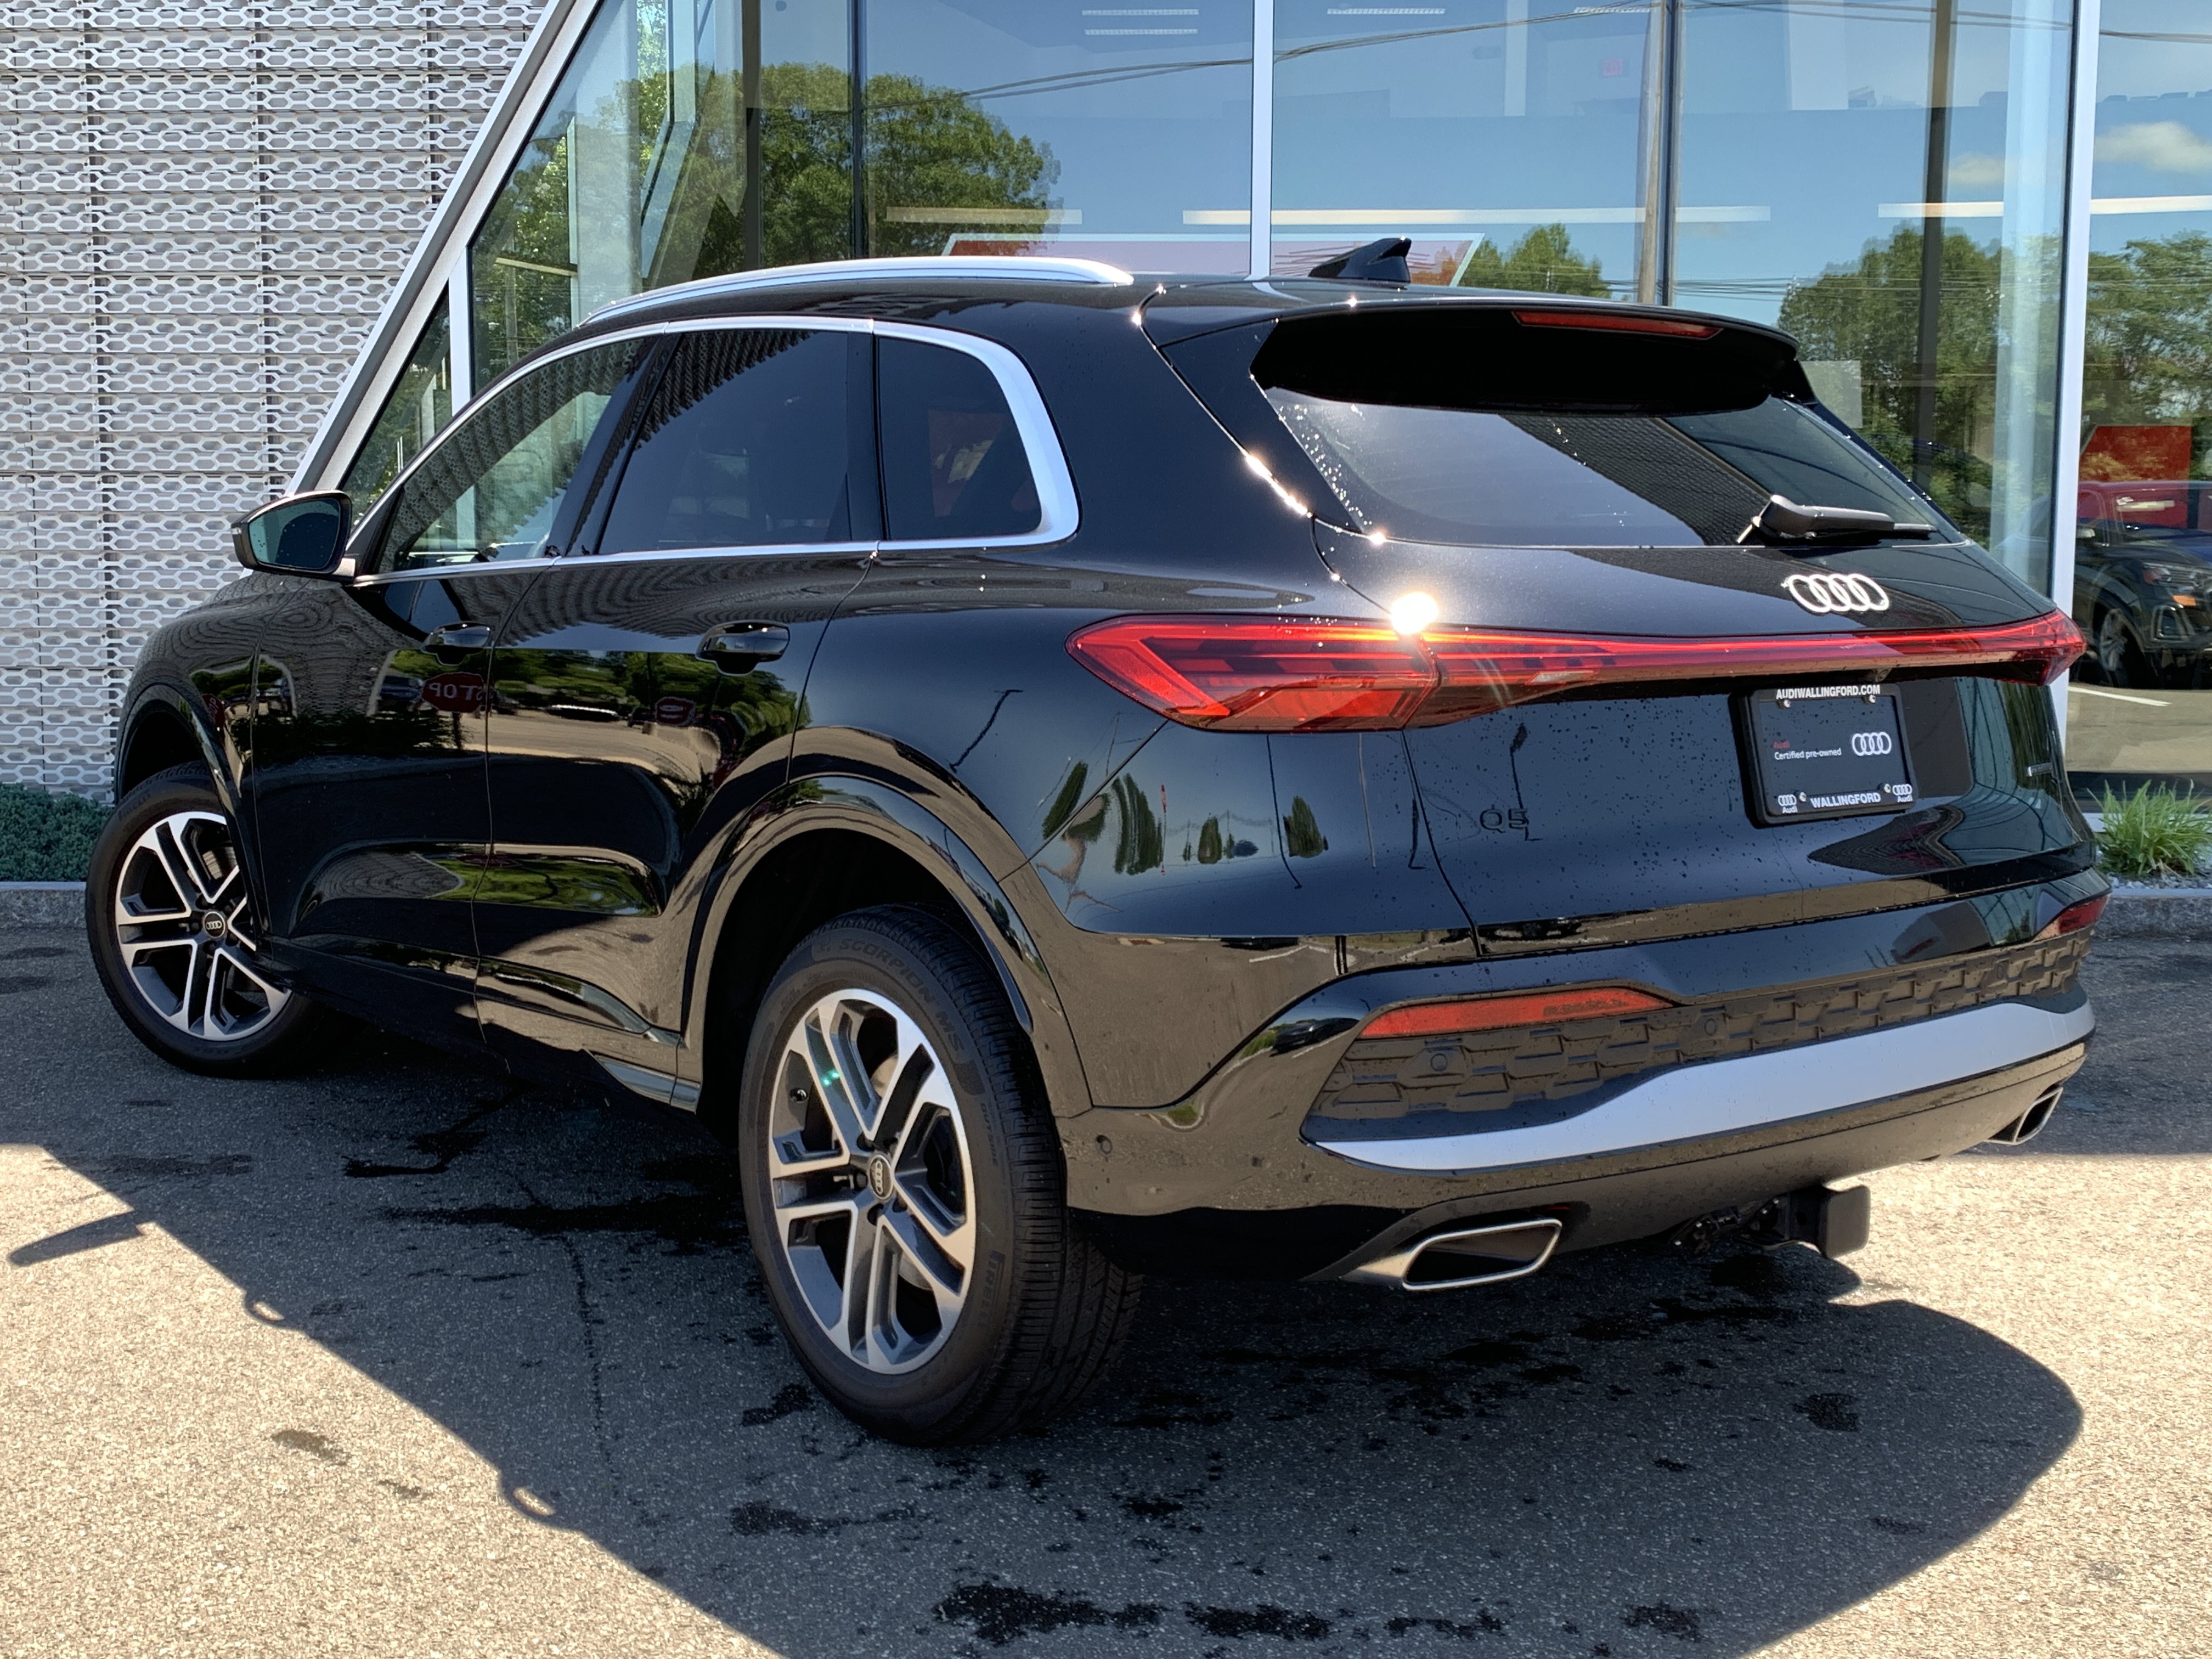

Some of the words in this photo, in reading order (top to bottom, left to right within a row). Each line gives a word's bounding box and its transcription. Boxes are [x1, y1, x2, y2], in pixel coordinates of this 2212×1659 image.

[1776, 685, 1880, 699] AUDIWALLINGFORD.COM
[1774, 751, 1804, 760] Certified
[1805, 748, 1842, 759] pre-owned
[1810, 793, 1881, 808] WALLINGFORD
[1480, 808, 1530, 833] Q5
[839, 939, 935, 1003] SCORPION
